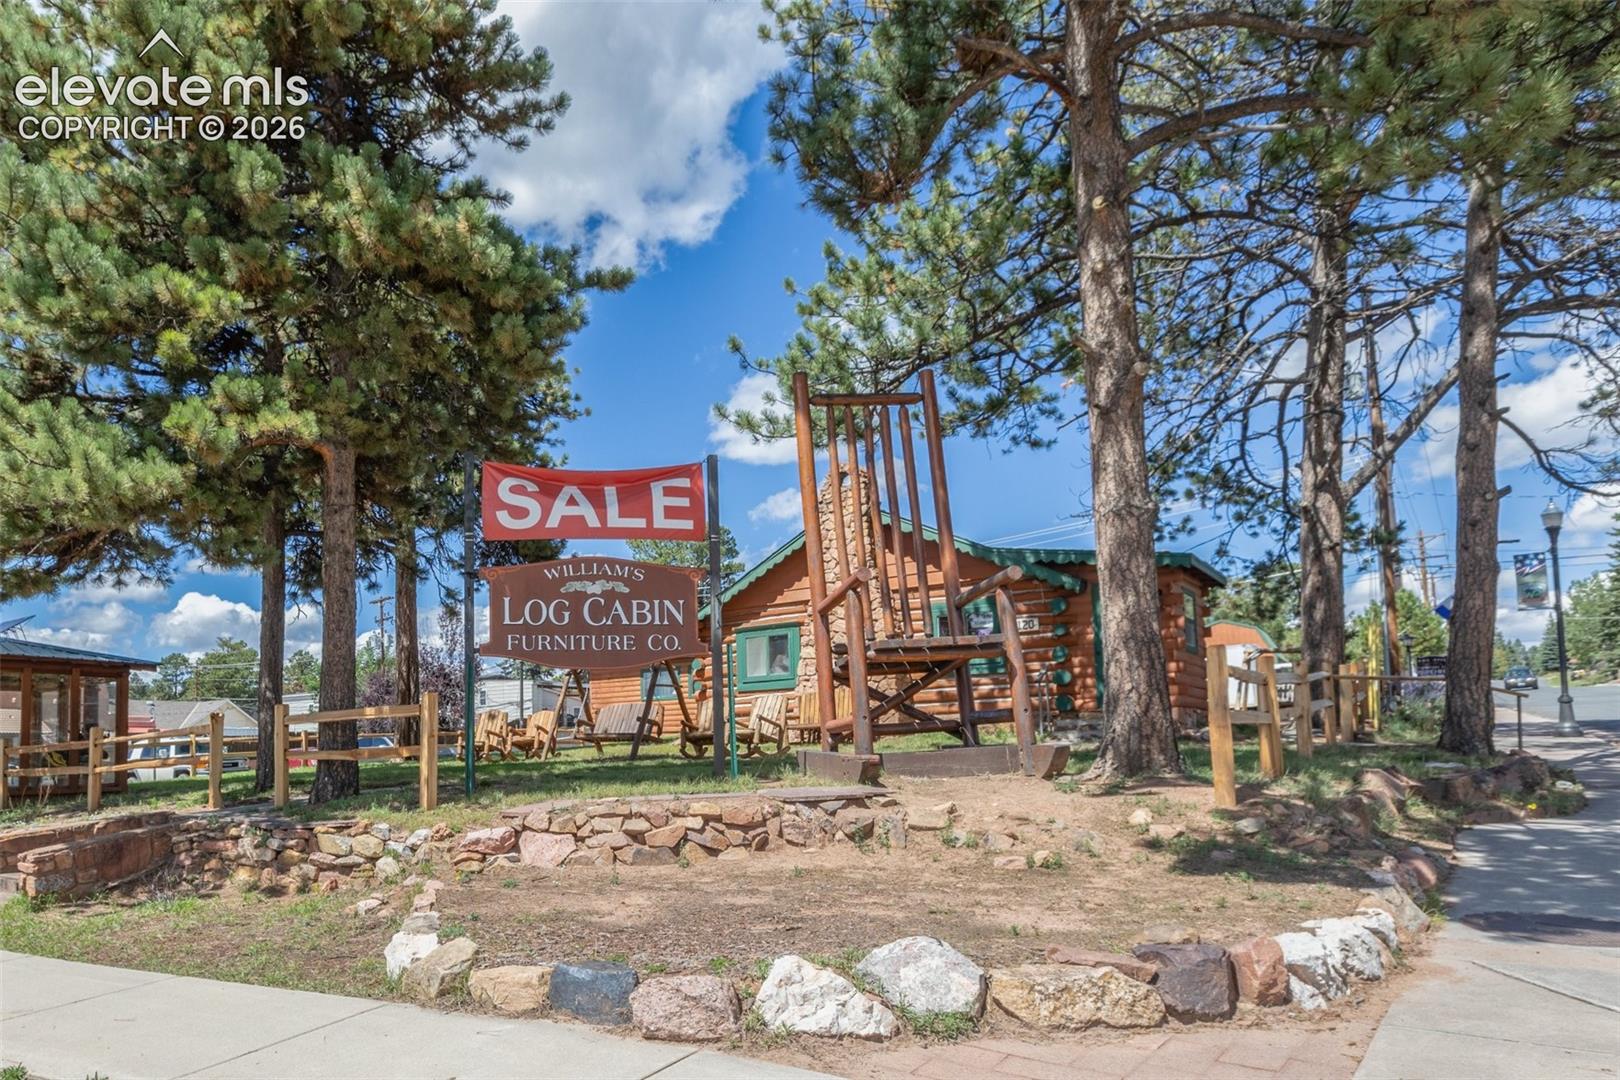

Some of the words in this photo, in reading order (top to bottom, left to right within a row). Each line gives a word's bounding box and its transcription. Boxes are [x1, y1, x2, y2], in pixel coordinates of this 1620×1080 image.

[495, 477, 694, 530] SALE
[543, 562, 646, 582] WILLIAM'S
[502, 597, 571, 626] LOG
[582, 597, 685, 626] CABIN
[507, 634, 636, 651] FURNITURE
[647, 634, 682, 651] CO.
